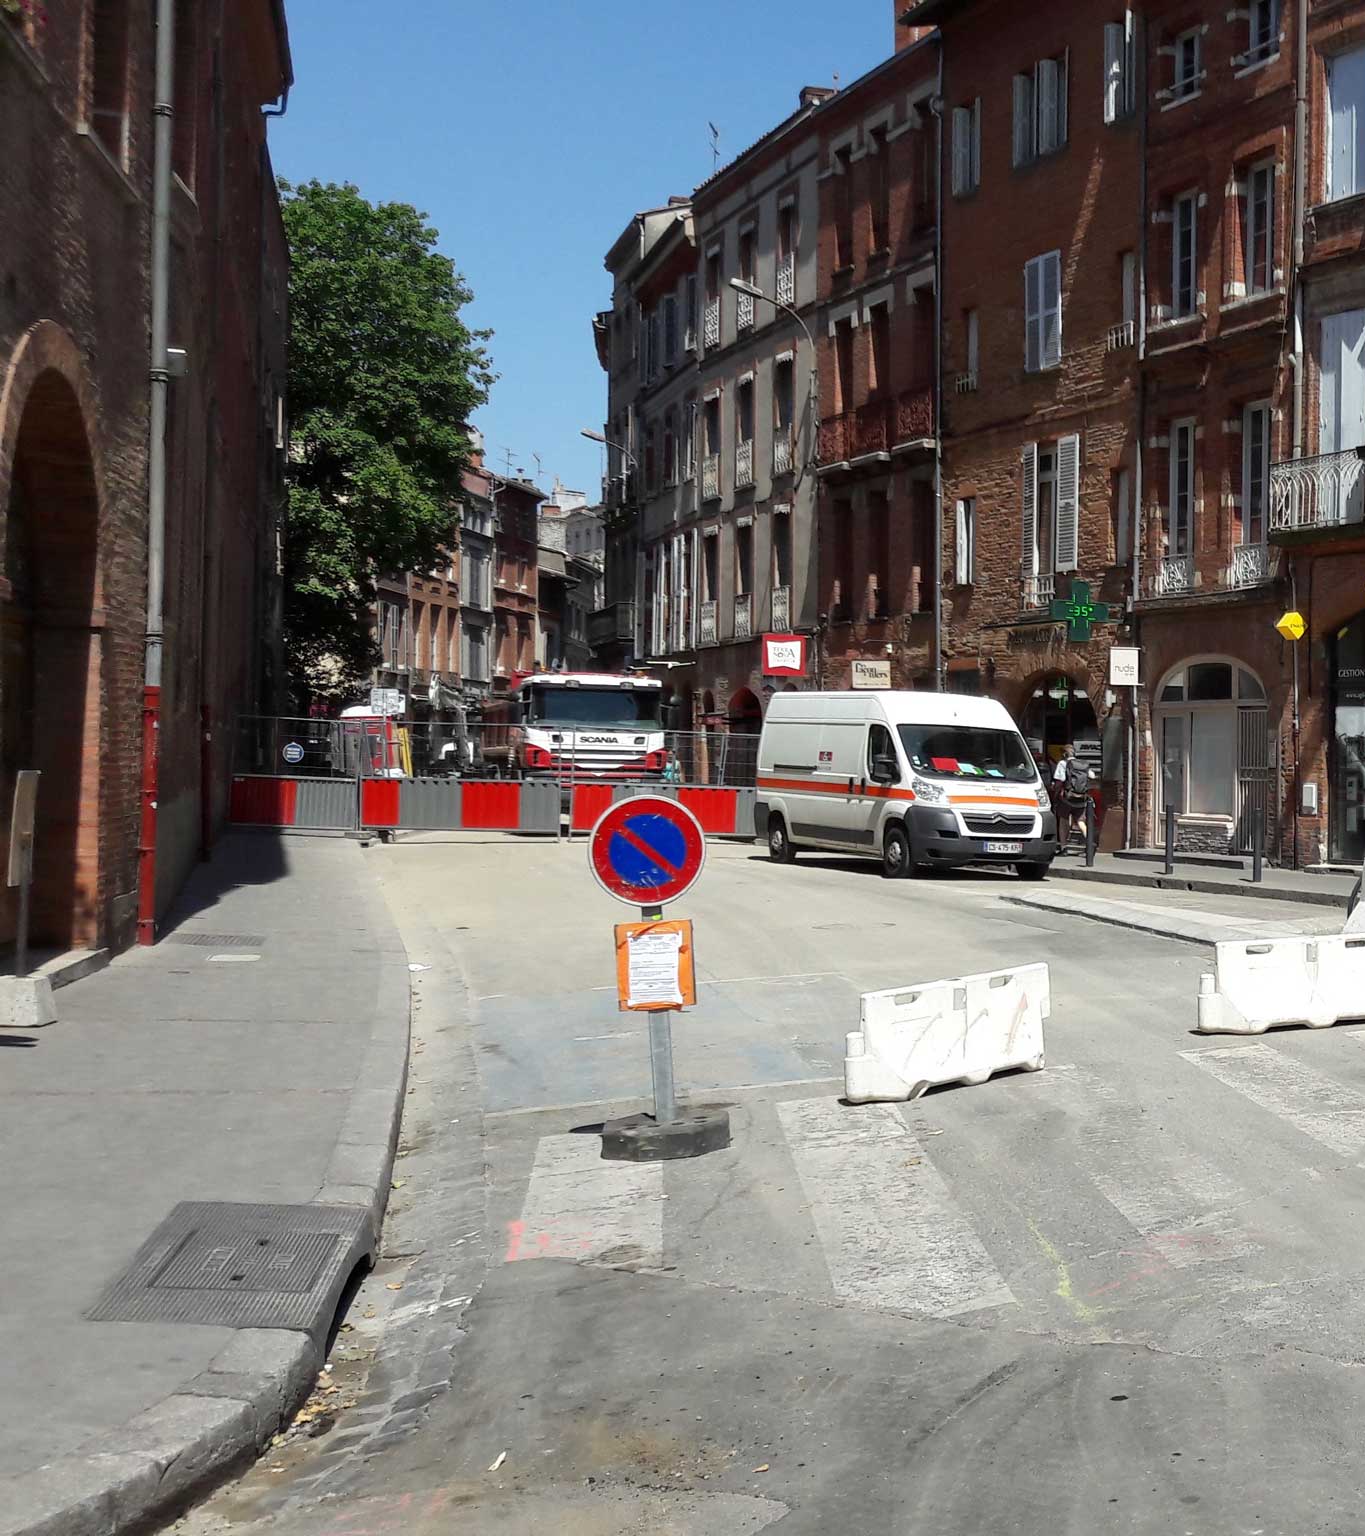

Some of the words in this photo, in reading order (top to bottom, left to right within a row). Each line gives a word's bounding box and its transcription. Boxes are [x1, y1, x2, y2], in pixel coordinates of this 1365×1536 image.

[1114, 663, 1135, 673] nude
[1338, 668, 1365, 678] GESTION
[580, 736, 619, 744] SCANIA
